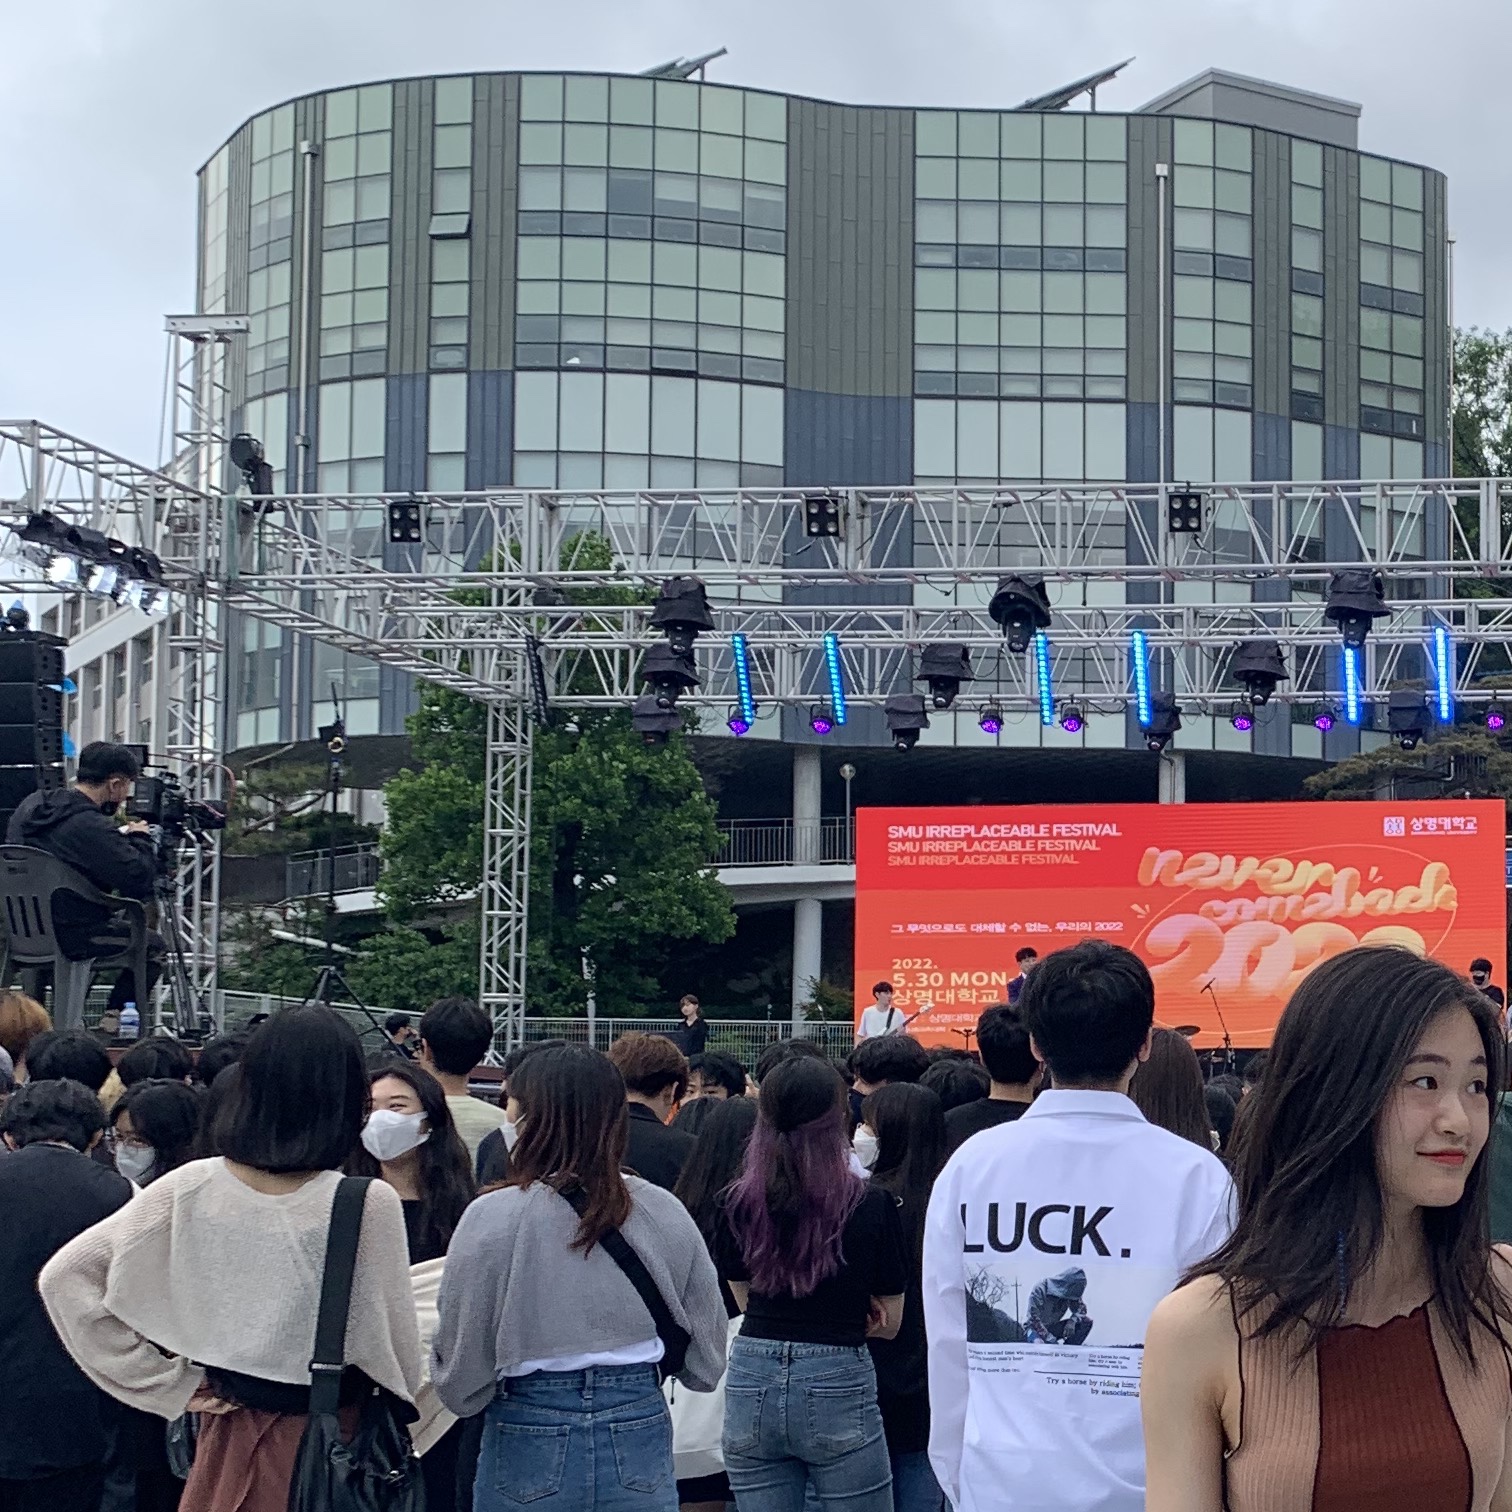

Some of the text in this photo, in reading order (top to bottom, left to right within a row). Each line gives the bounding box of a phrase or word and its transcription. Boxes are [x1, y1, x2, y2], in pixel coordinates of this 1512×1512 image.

[888, 823, 1122, 838] SMU IRREPLACEABLE FESTIVAL
[1410, 817, 1477, 831] 상명대학교
[888, 839, 1101, 853] SMU IRREPLACEABLE FESTIVAL
[888, 853, 1080, 866] SMU IRREPLACEABLE FESTIVAL
[891, 924, 904, 933] 그
[1009, 922, 1022, 933] 수
[1054, 921, 1092, 932] 우리의
[1095, 921, 1123, 931] 2022
[892, 958, 938, 969] 2022.
[892, 971, 1007, 987] 5.30 MON
[892, 988, 1000, 1005] 상명대학교
[1046, 1376, 1059, 1385] Try
[1089, 1379, 1098, 1387] by
[1100, 1380, 1120, 1388] riding
[1091, 1387, 1099, 1395] by
